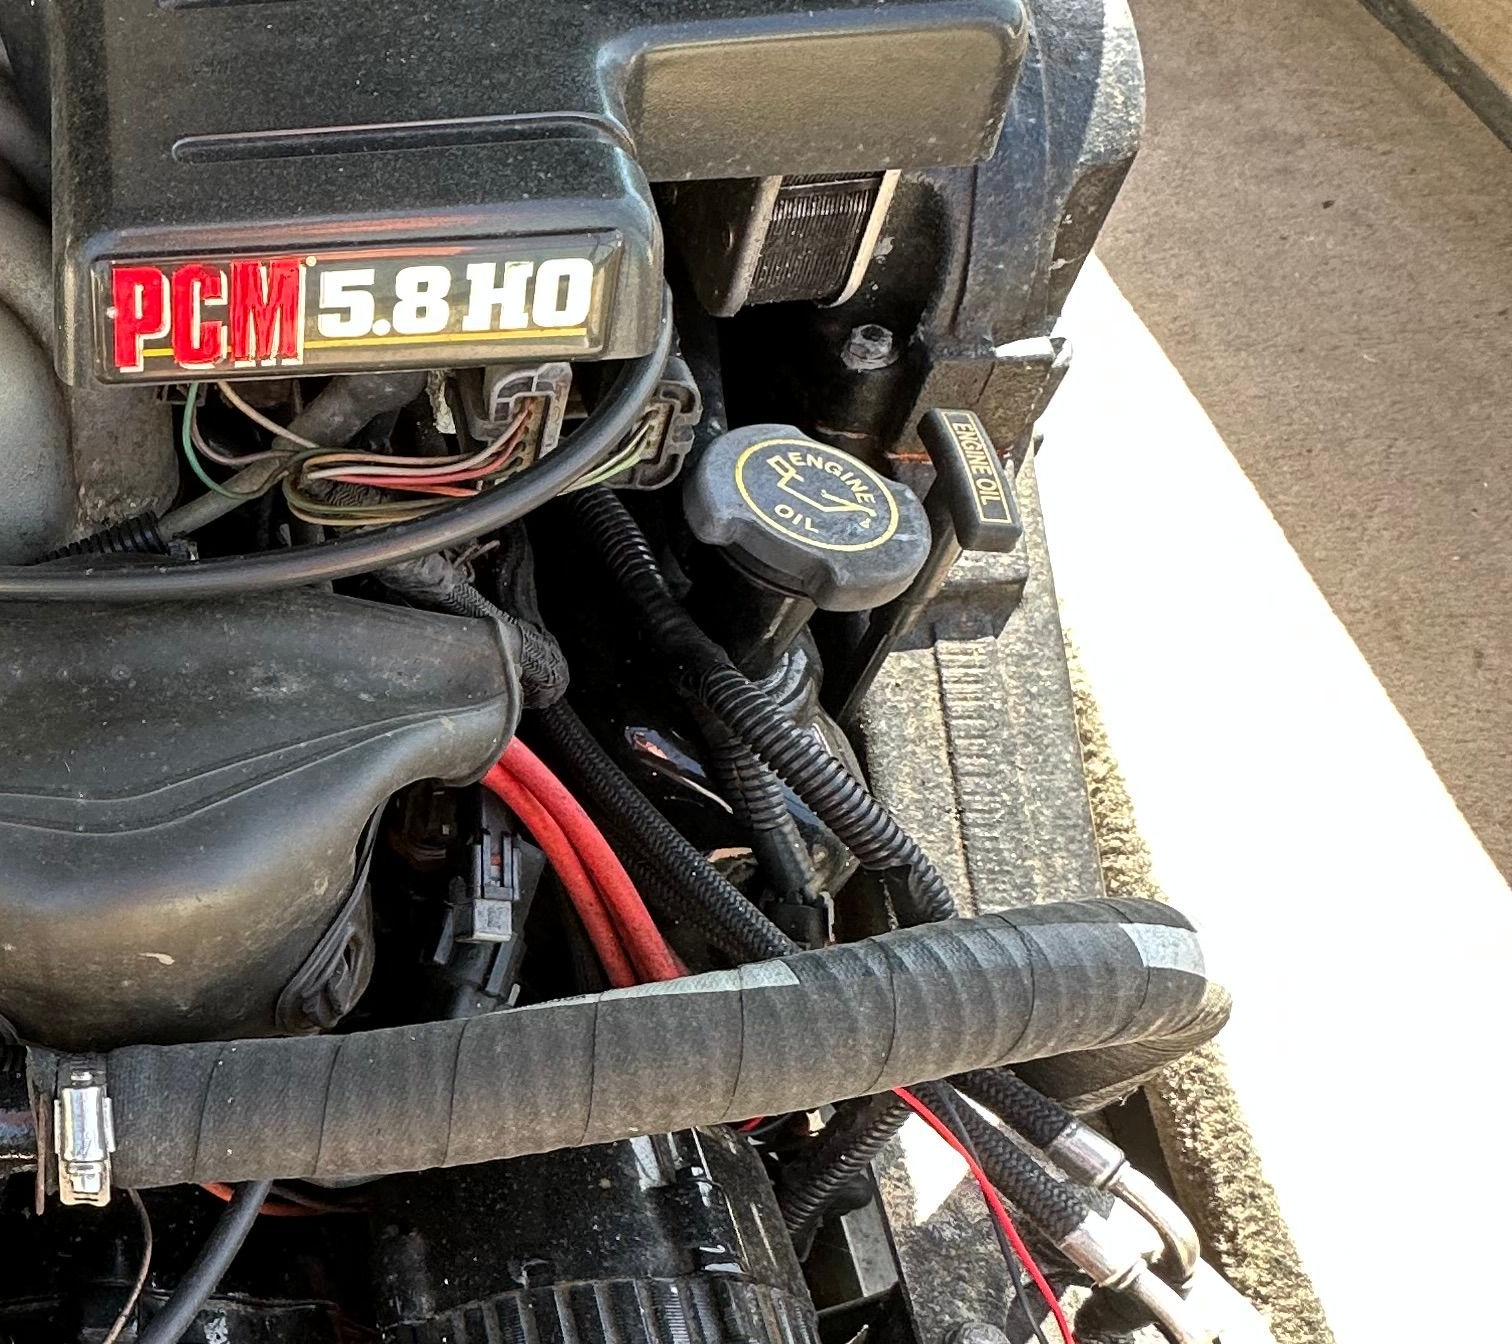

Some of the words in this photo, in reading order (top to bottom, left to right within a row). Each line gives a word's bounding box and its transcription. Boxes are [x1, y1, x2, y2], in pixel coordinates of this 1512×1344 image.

[110, 257, 305, 372] PCM
[787, 451, 877, 504] ENGINE
[952, 422, 993, 476] ENGINE
[975, 478, 1001, 506] OIL
[774, 504, 819, 534] OIL
